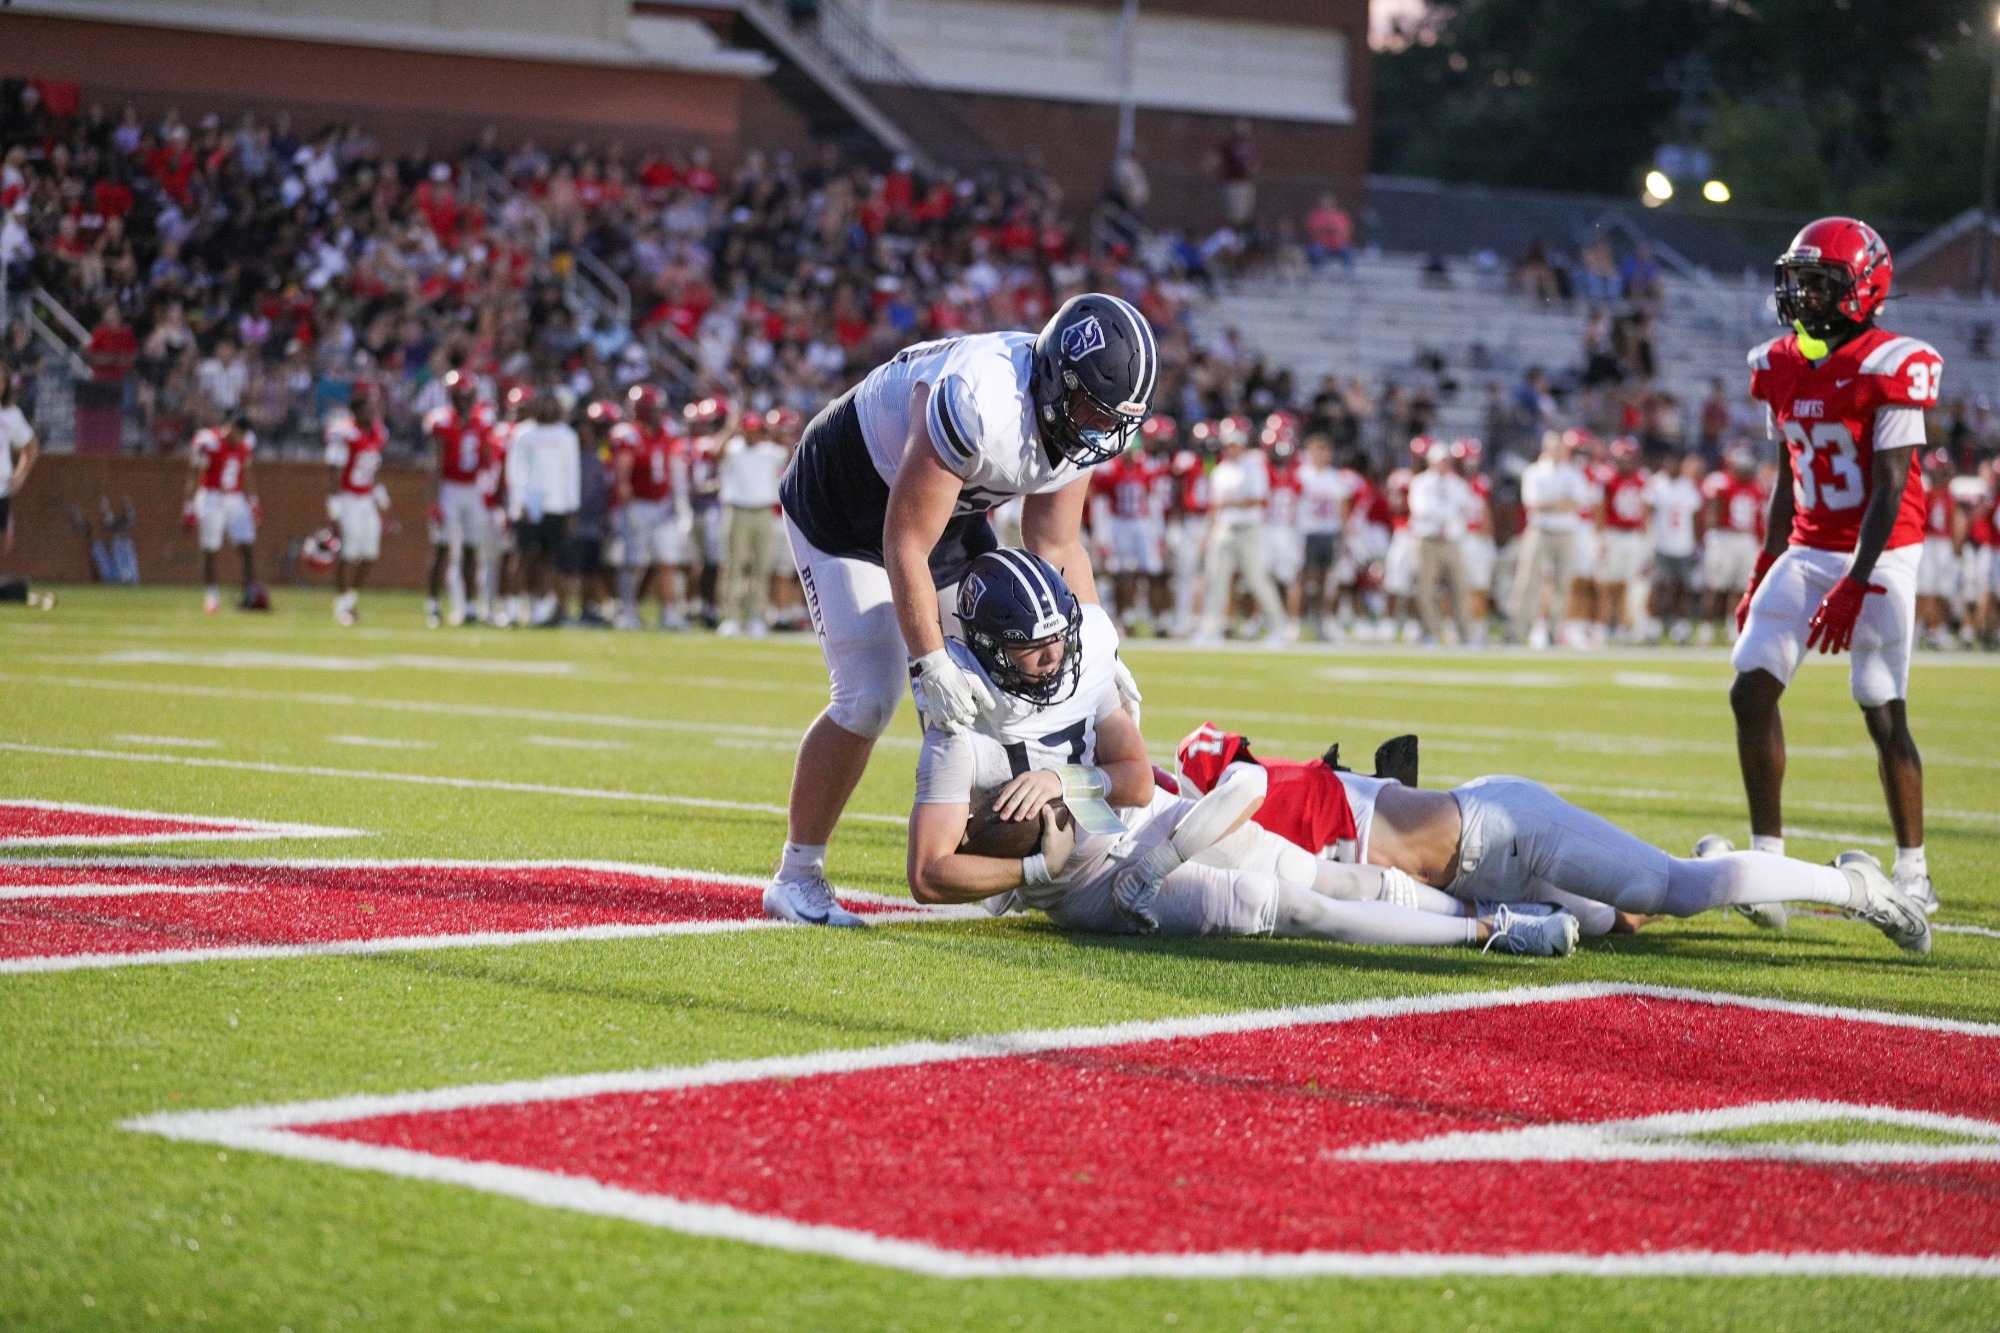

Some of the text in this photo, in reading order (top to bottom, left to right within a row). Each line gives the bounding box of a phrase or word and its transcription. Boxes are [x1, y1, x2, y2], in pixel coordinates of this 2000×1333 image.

[1793, 399, 1824, 418] HAWKS
[1907, 362, 1942, 400] 33
[1783, 421, 1865, 510] 33
[801, 565, 826, 639] BERRY
[1003, 718, 1086, 779] 17
